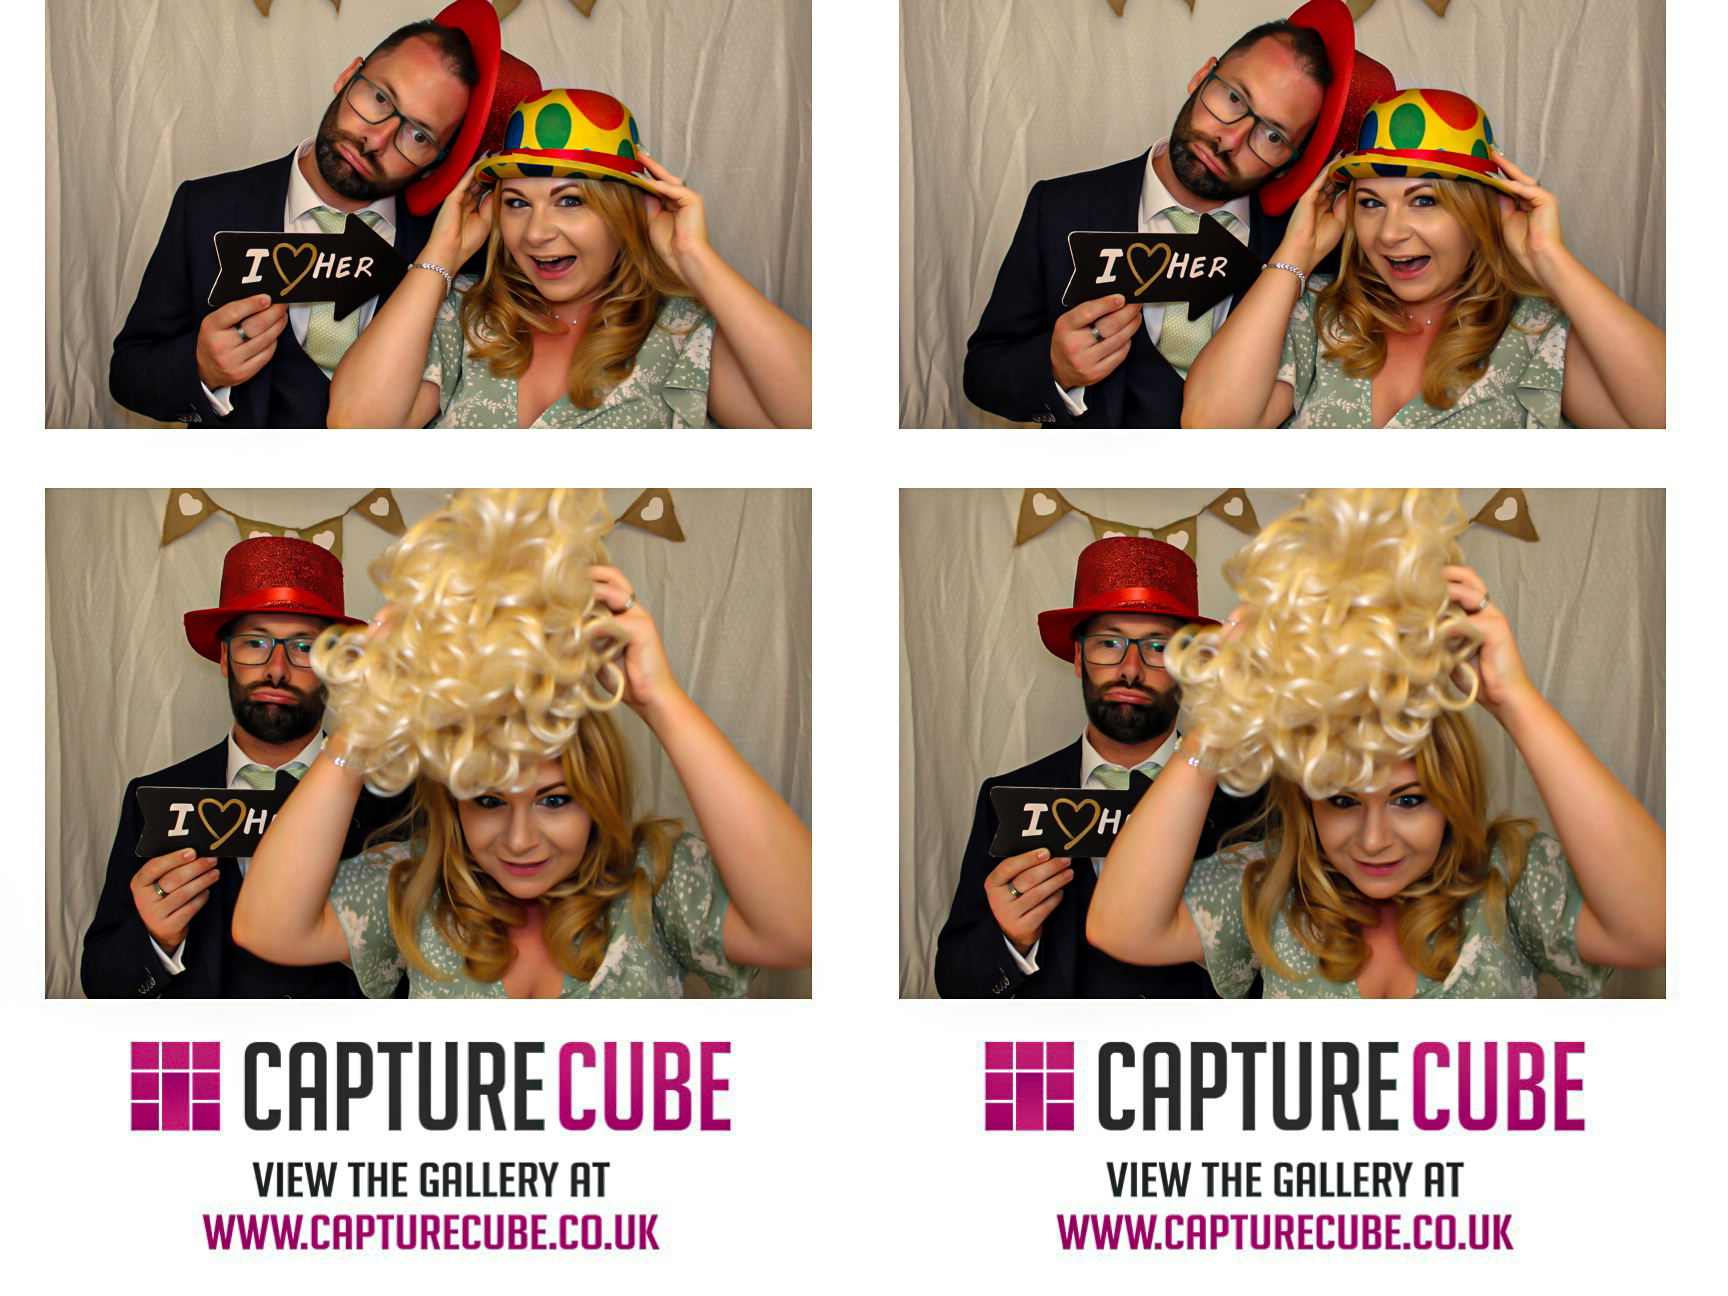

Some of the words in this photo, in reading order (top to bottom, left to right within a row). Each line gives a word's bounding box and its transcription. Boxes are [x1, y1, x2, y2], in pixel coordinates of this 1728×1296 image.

[241, 248, 270, 284] I
[312, 251, 374, 279] HER
[1095, 248, 1124, 284] I
[1166, 251, 1228, 279] HER
[167, 802, 195, 837] I
[243, 807, 278, 835] H
[1021, 802, 1049, 837] I
[1097, 807, 1132, 835] H
